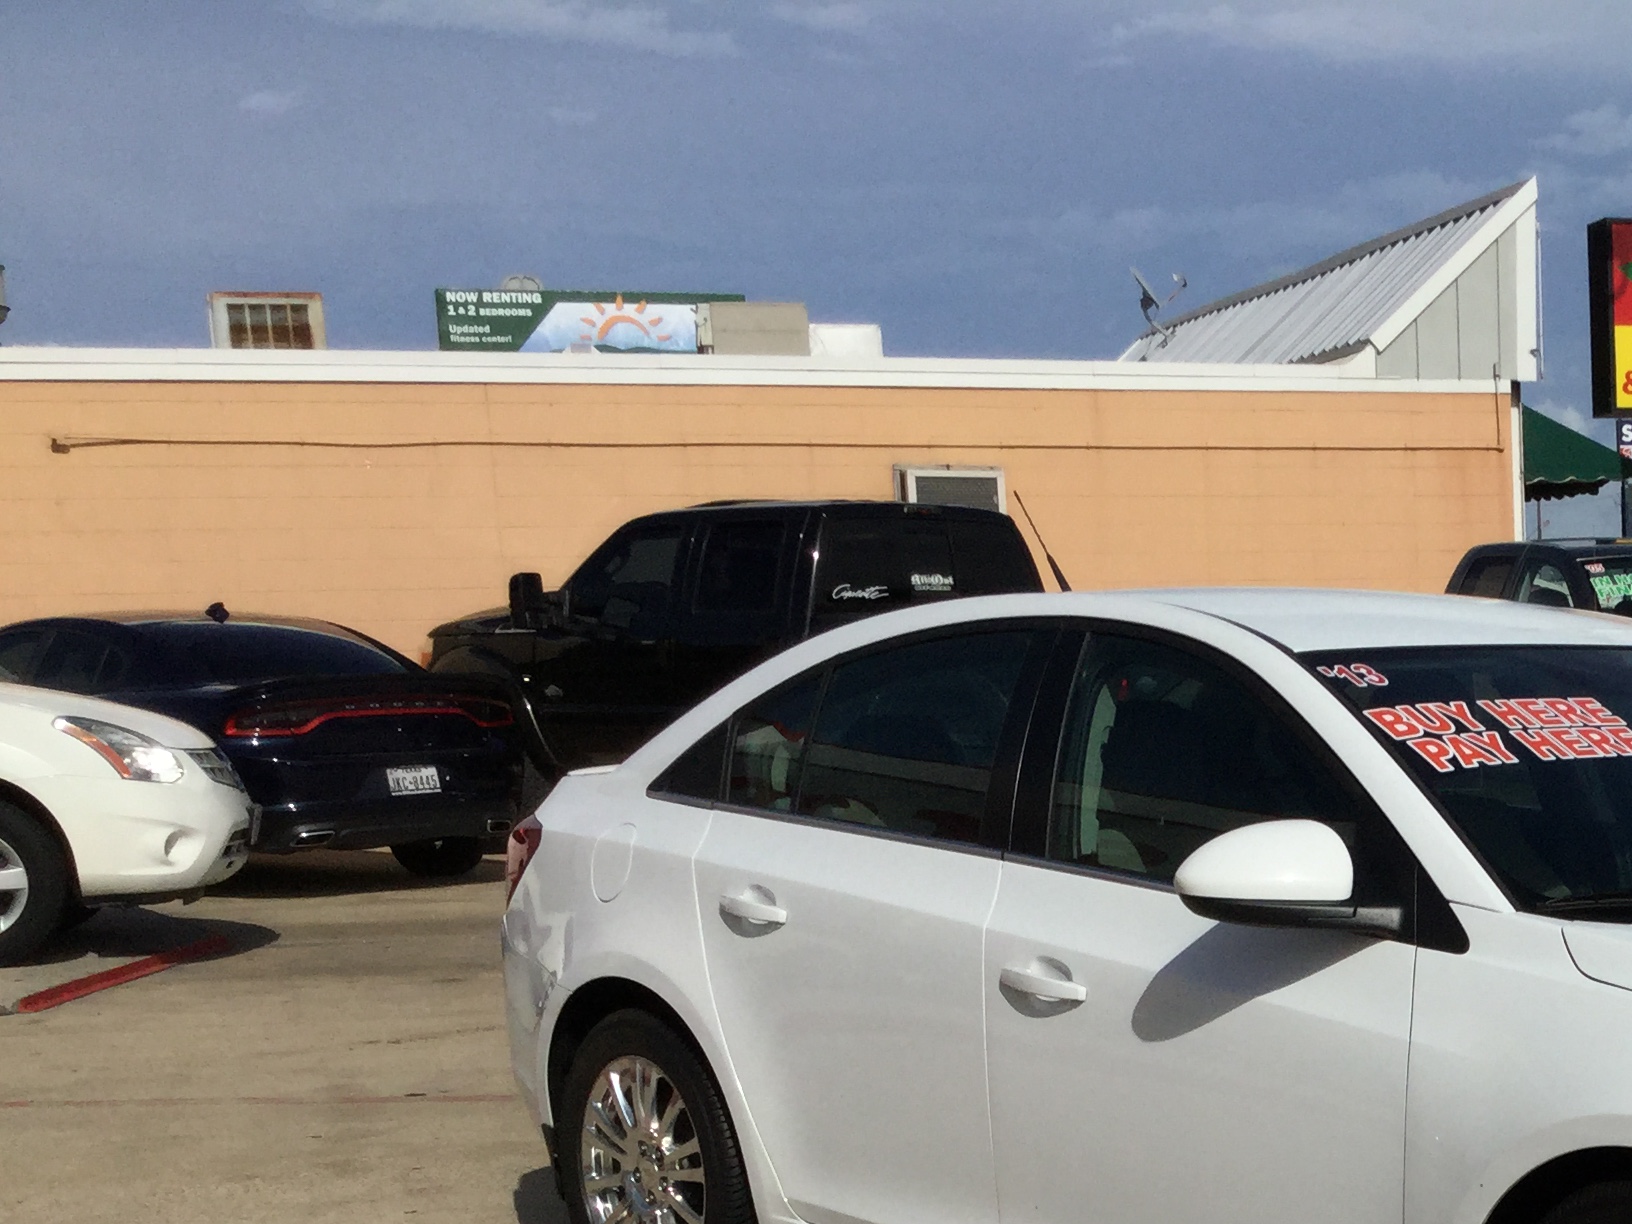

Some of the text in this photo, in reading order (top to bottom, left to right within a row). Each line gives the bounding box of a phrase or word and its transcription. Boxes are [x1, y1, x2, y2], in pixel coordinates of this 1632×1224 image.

[446, 291, 542, 304] NOW RENTING
[447, 304, 456, 316] 1
[467, 304, 476, 316] 2
[479, 307, 532, 316] BEDROOMS
[448, 324, 490, 334] Updated
[1317, 663, 1389, 688] '13
[1363, 697, 1628, 740] BUY HERE
[1406, 731, 1520, 772] PAY
